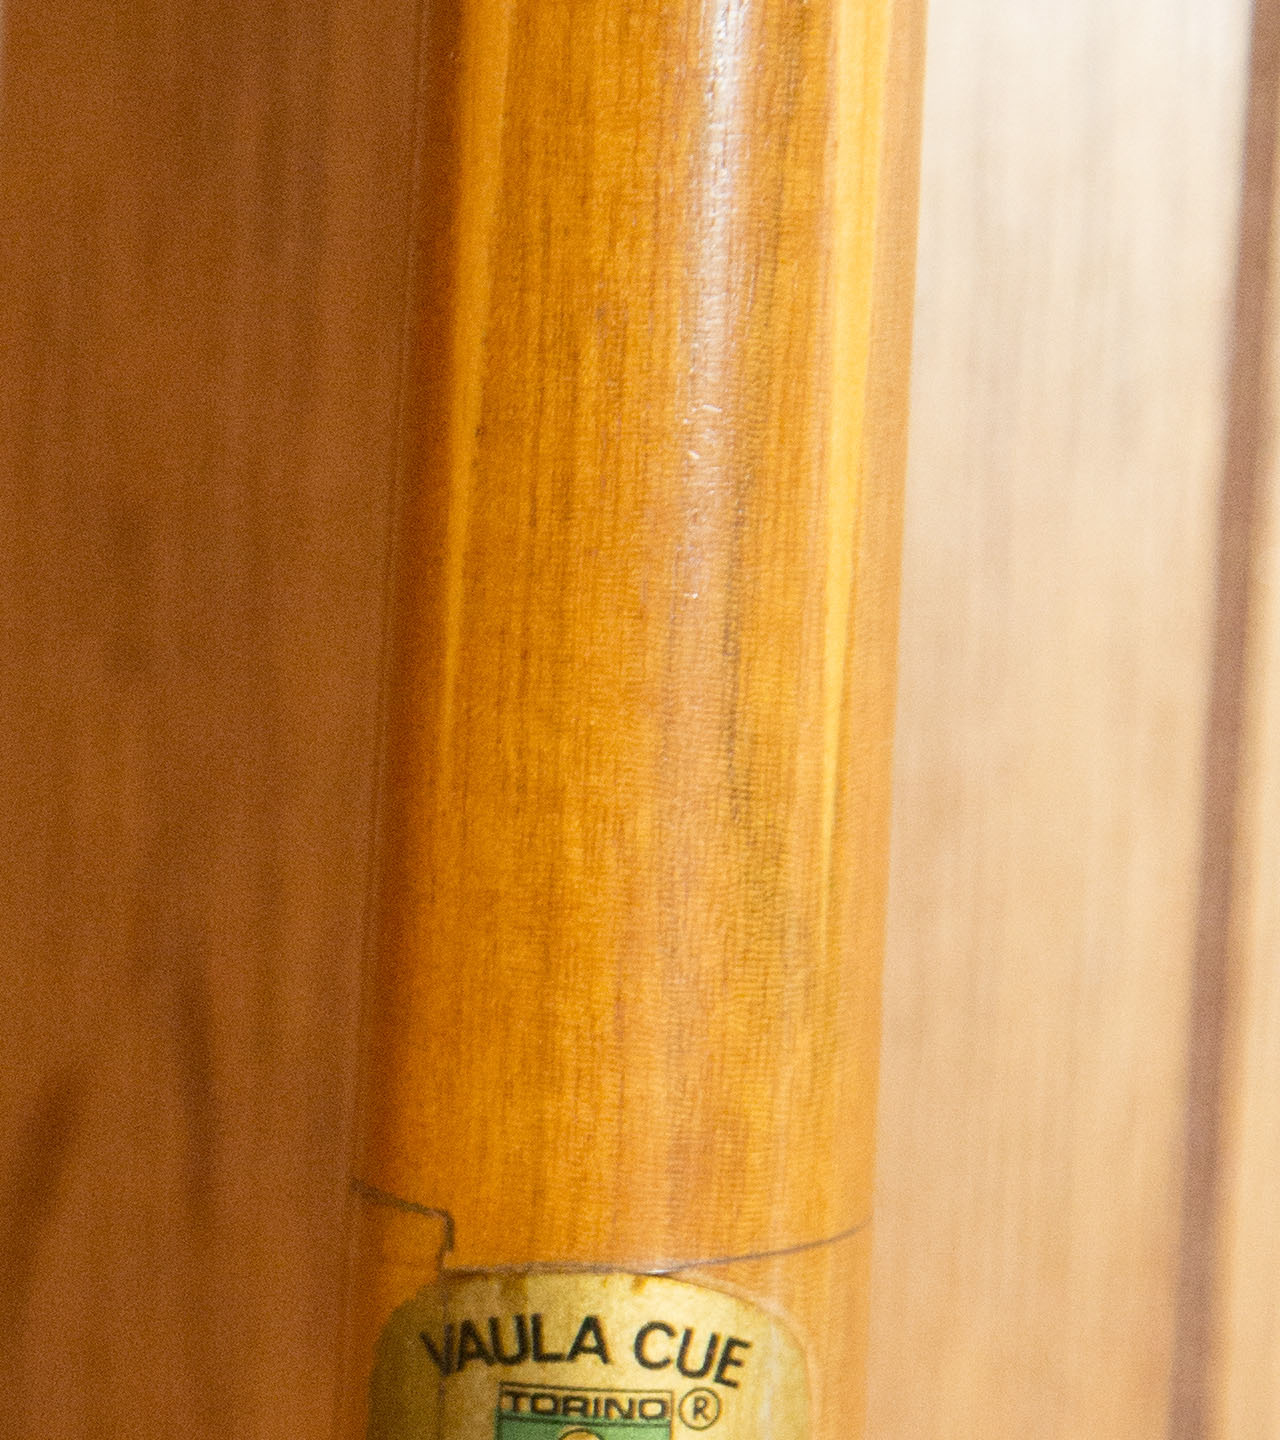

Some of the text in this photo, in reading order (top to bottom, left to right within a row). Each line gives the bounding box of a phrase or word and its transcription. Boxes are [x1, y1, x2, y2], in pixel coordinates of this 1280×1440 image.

[419, 1312, 752, 1389] VAULA CUE
[502, 1390, 670, 1420] TORINO
